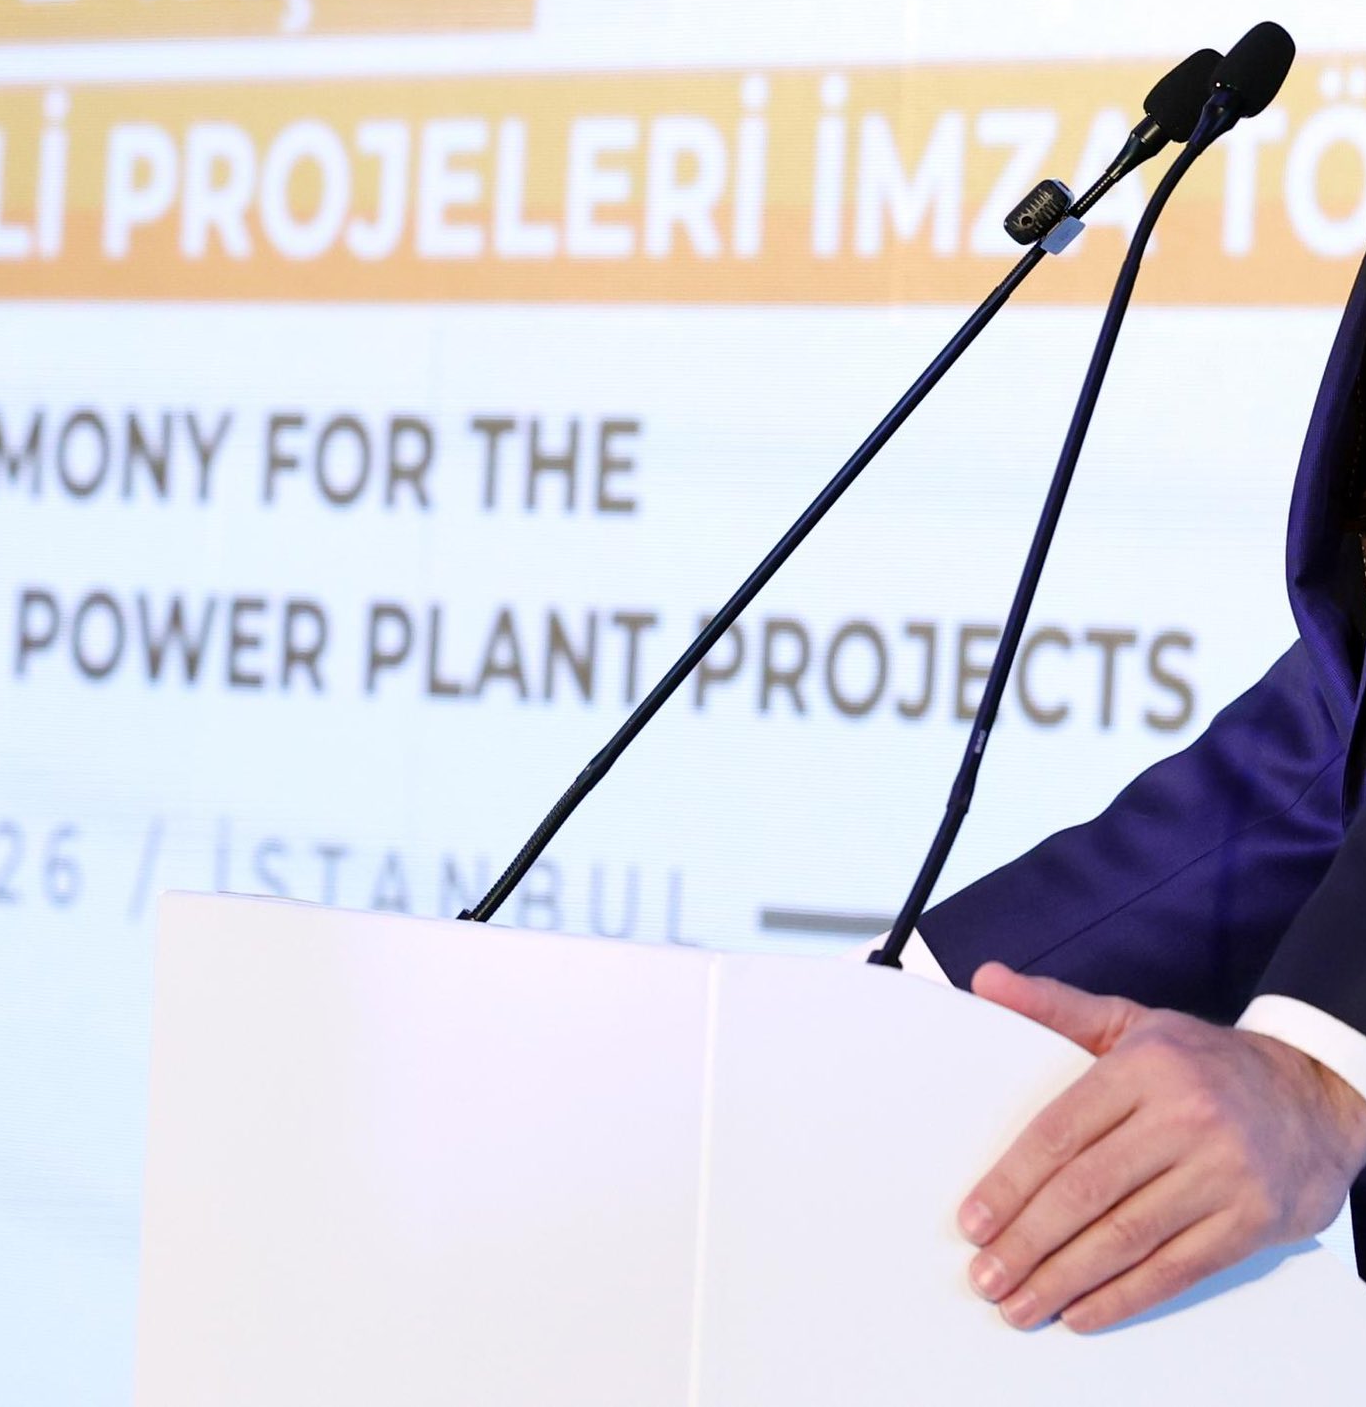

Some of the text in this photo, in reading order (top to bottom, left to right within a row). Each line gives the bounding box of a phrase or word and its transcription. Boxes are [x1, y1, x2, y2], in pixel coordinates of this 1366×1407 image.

[101, 73, 770, 261] PROJELERİ
[811, 73, 1159, 262] İMZA
[263, 412, 438, 510] FOR
[471, 415, 641, 515] THE
[14, 587, 329, 691] POWER
[364, 603, 659, 709] PLANT
[695, 613, 1199, 735] PROJECTS
